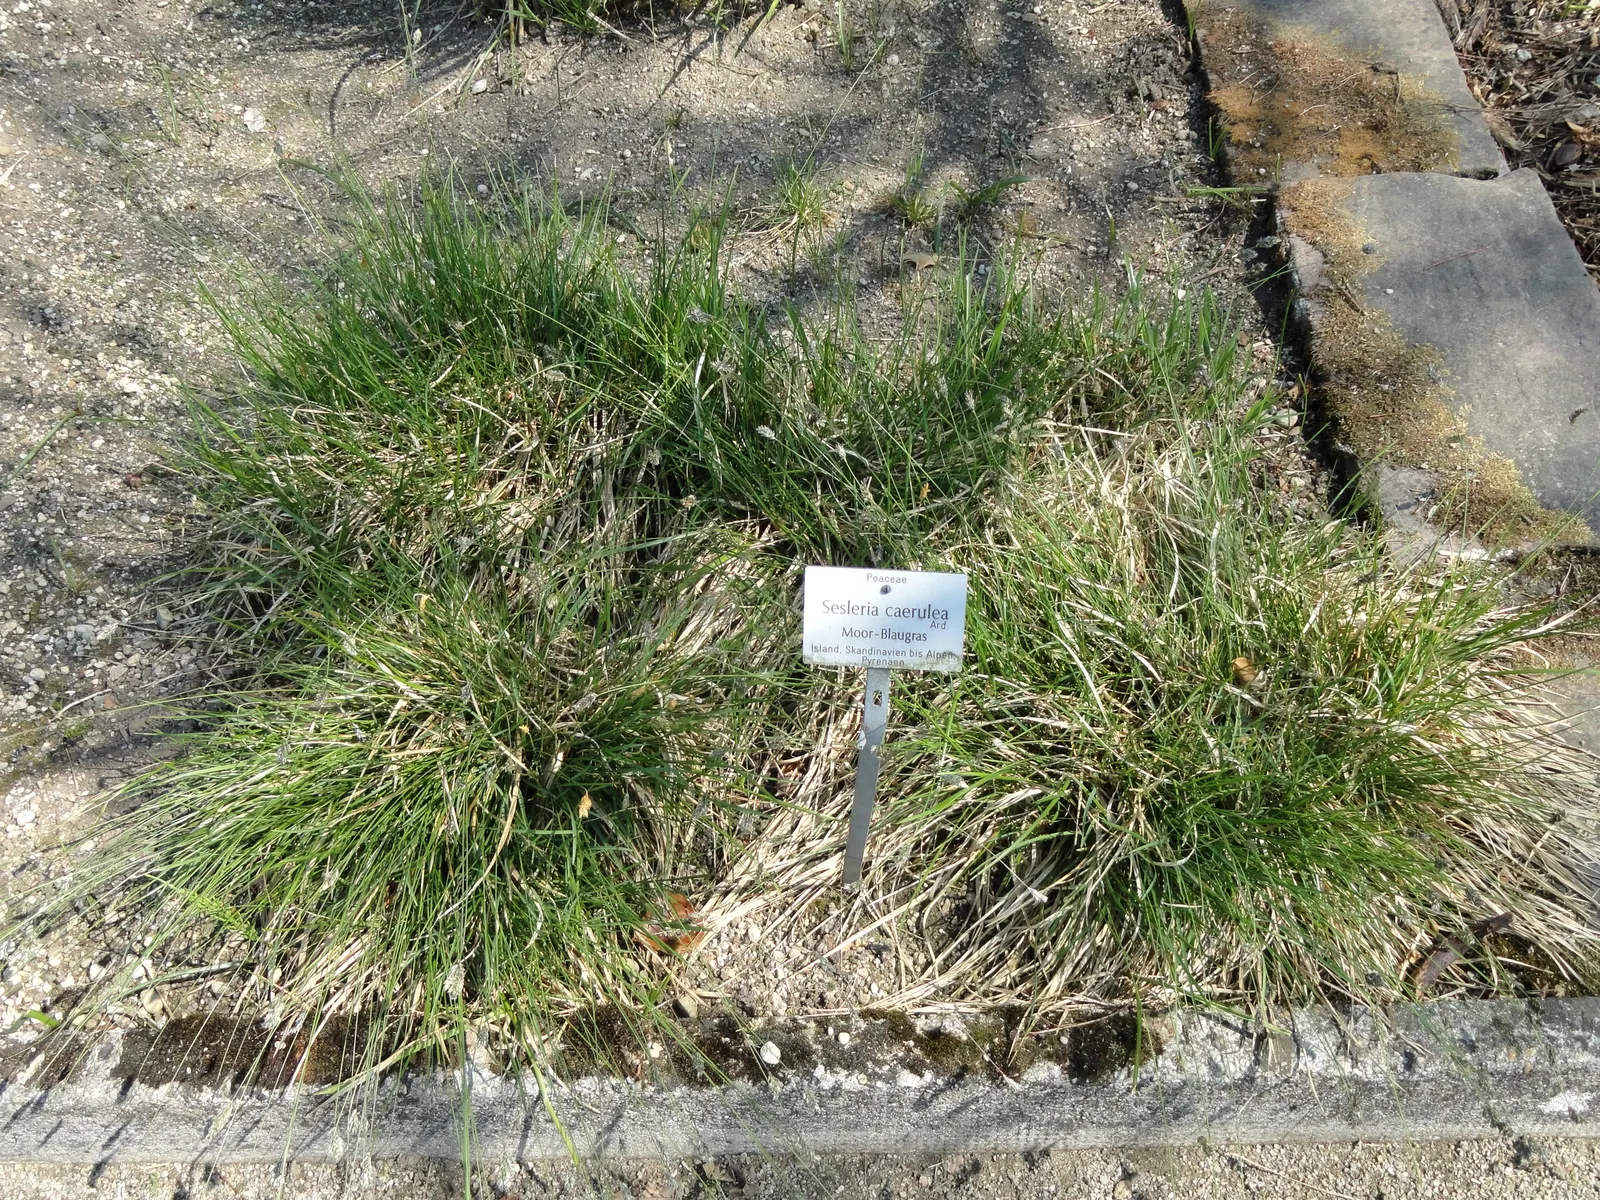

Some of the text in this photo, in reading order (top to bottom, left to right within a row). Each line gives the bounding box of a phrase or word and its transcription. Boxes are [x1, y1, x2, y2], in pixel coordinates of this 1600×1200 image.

[866, 573, 908, 584] Poaceae
[822, 600, 949, 620] Sesleria caerulea
[929, 620, 949, 630] Ard.
[841, 626, 928, 643] Moor-Blaugras
[845, 645, 907, 658] Skandinavien
[909, 649, 923, 658] bis
